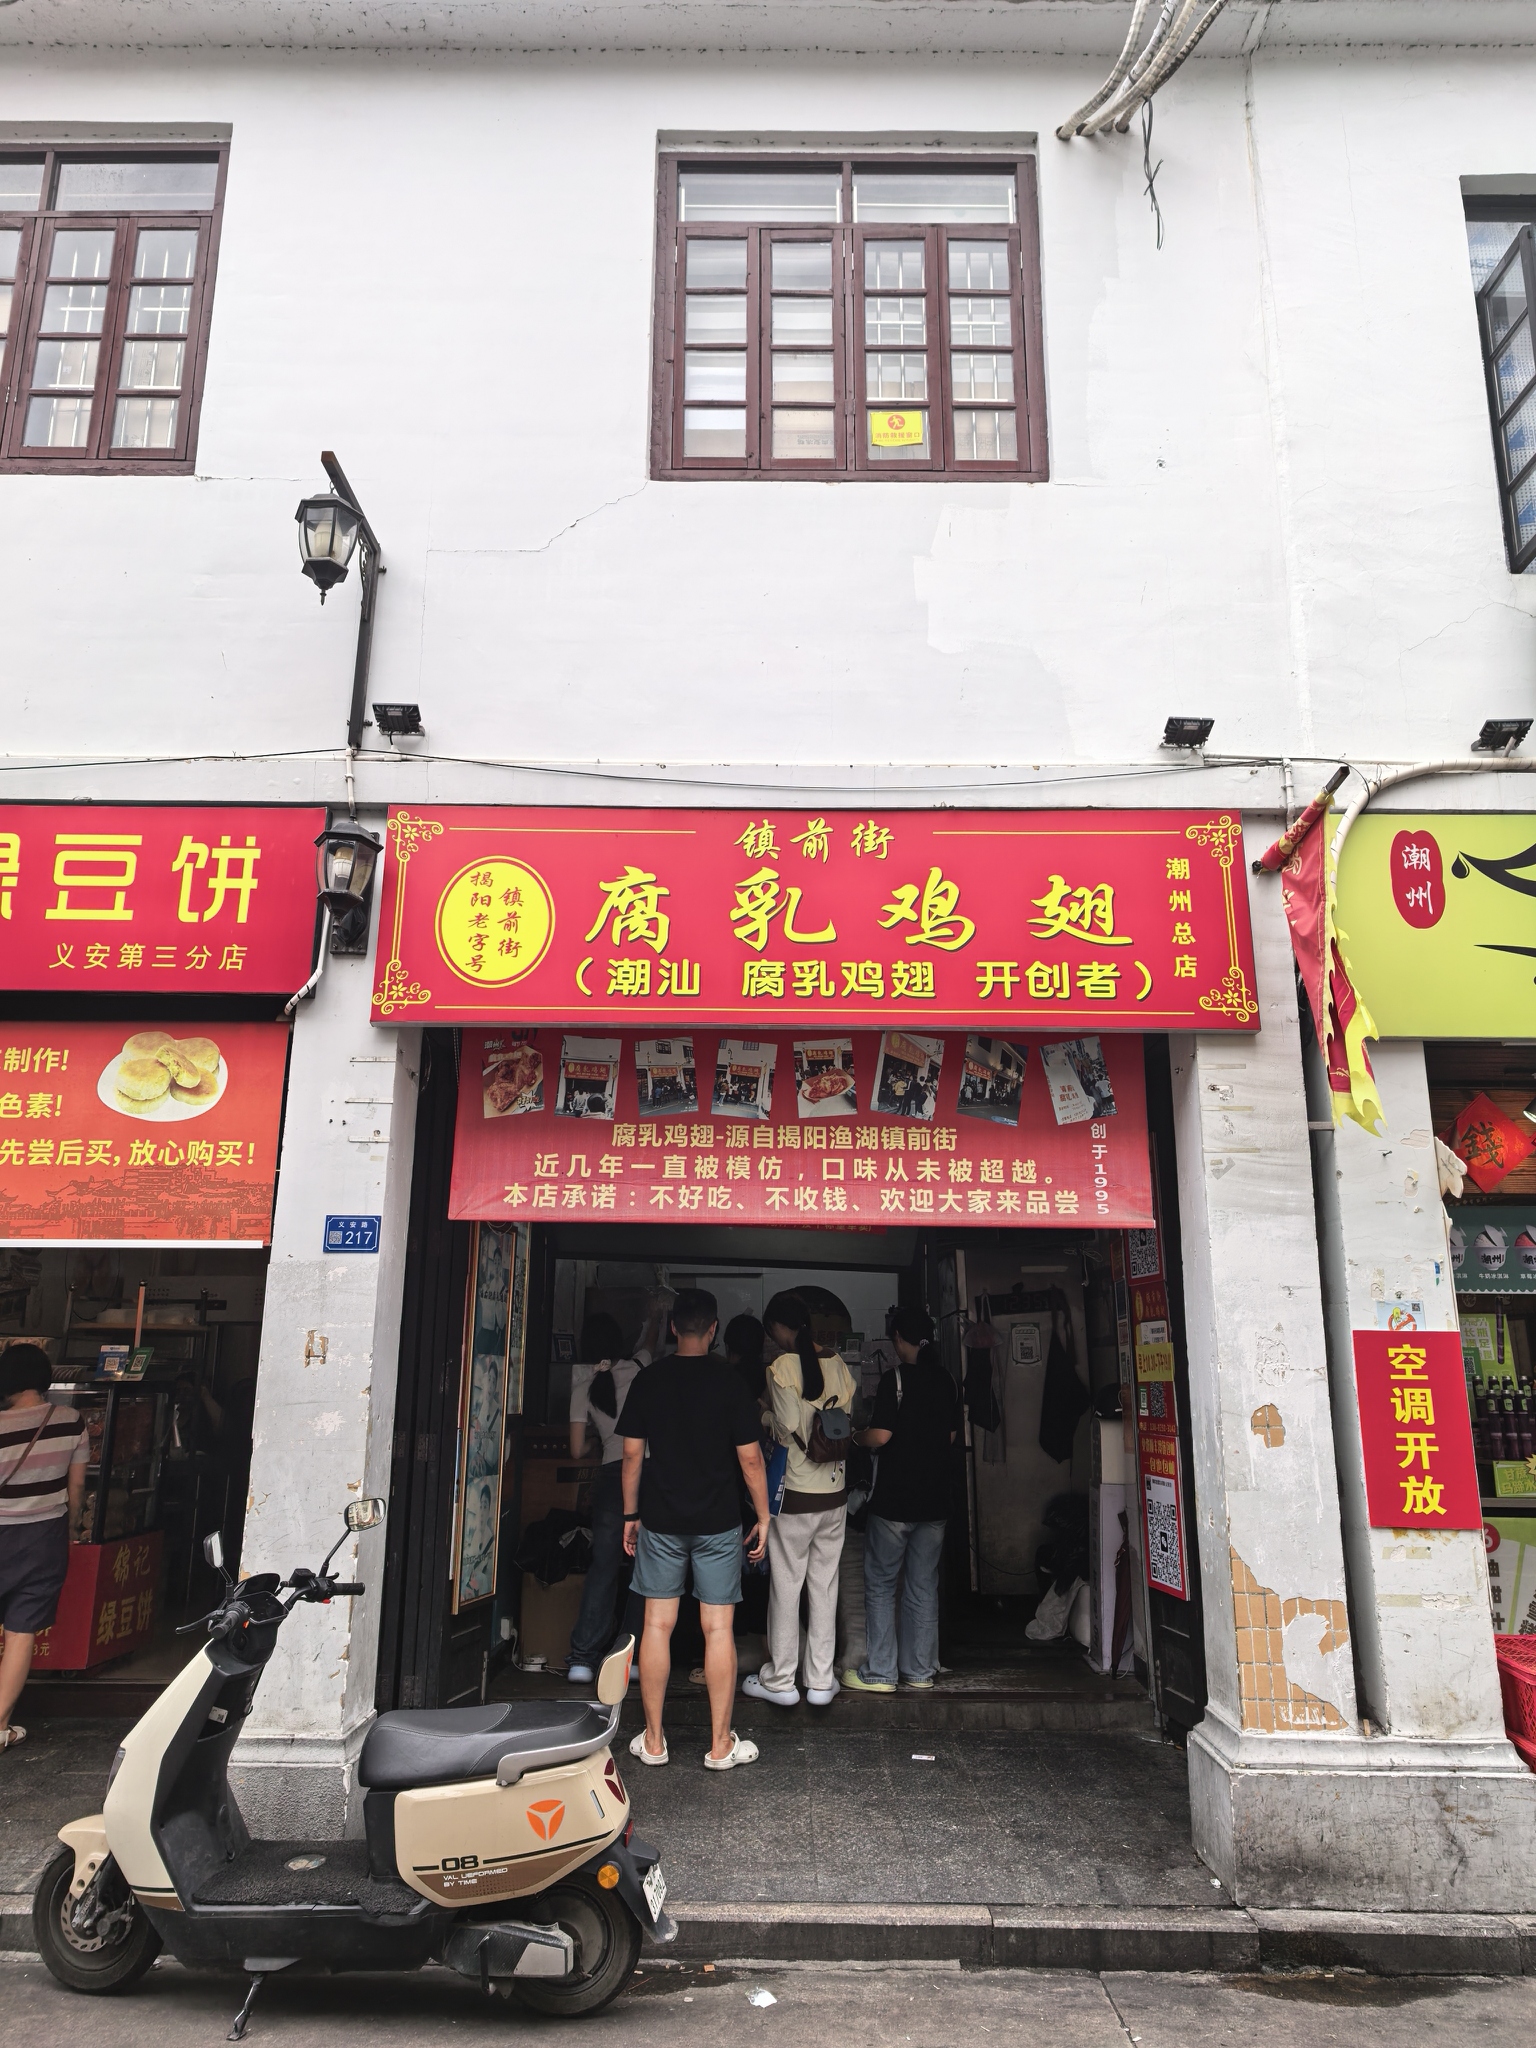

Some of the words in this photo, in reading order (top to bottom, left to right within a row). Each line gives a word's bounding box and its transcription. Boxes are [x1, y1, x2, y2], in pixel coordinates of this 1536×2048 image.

[734, 817, 894, 863] 镇前街
[1401, 843, 1434, 915] 潮州
[464, 870, 494, 974] 揭阳老字号
[498, 887, 525, 958] 镇前街
[585, 866, 1133, 953] 腐乳鸡翅
[1165, 857, 1198, 979] 潮州总店
[49, 942, 248, 970] 义安第三分店
[742, 958, 937, 999] 腐乳鸡翅
[0, 1047, 70, 1073] 制作！
[612, 1122, 957, 1152] 腐乳鸡翅-源自揭阳渔湖镇前街
[1091, 1122, 1110, 1215] 创于1995
[345, 1231, 373, 1245] 217
[1387, 1344, 1448, 1516] 空调开放
[96, 1589, 154, 1646] 绿豆饼
[442, 1855, 479, 1871] 08
